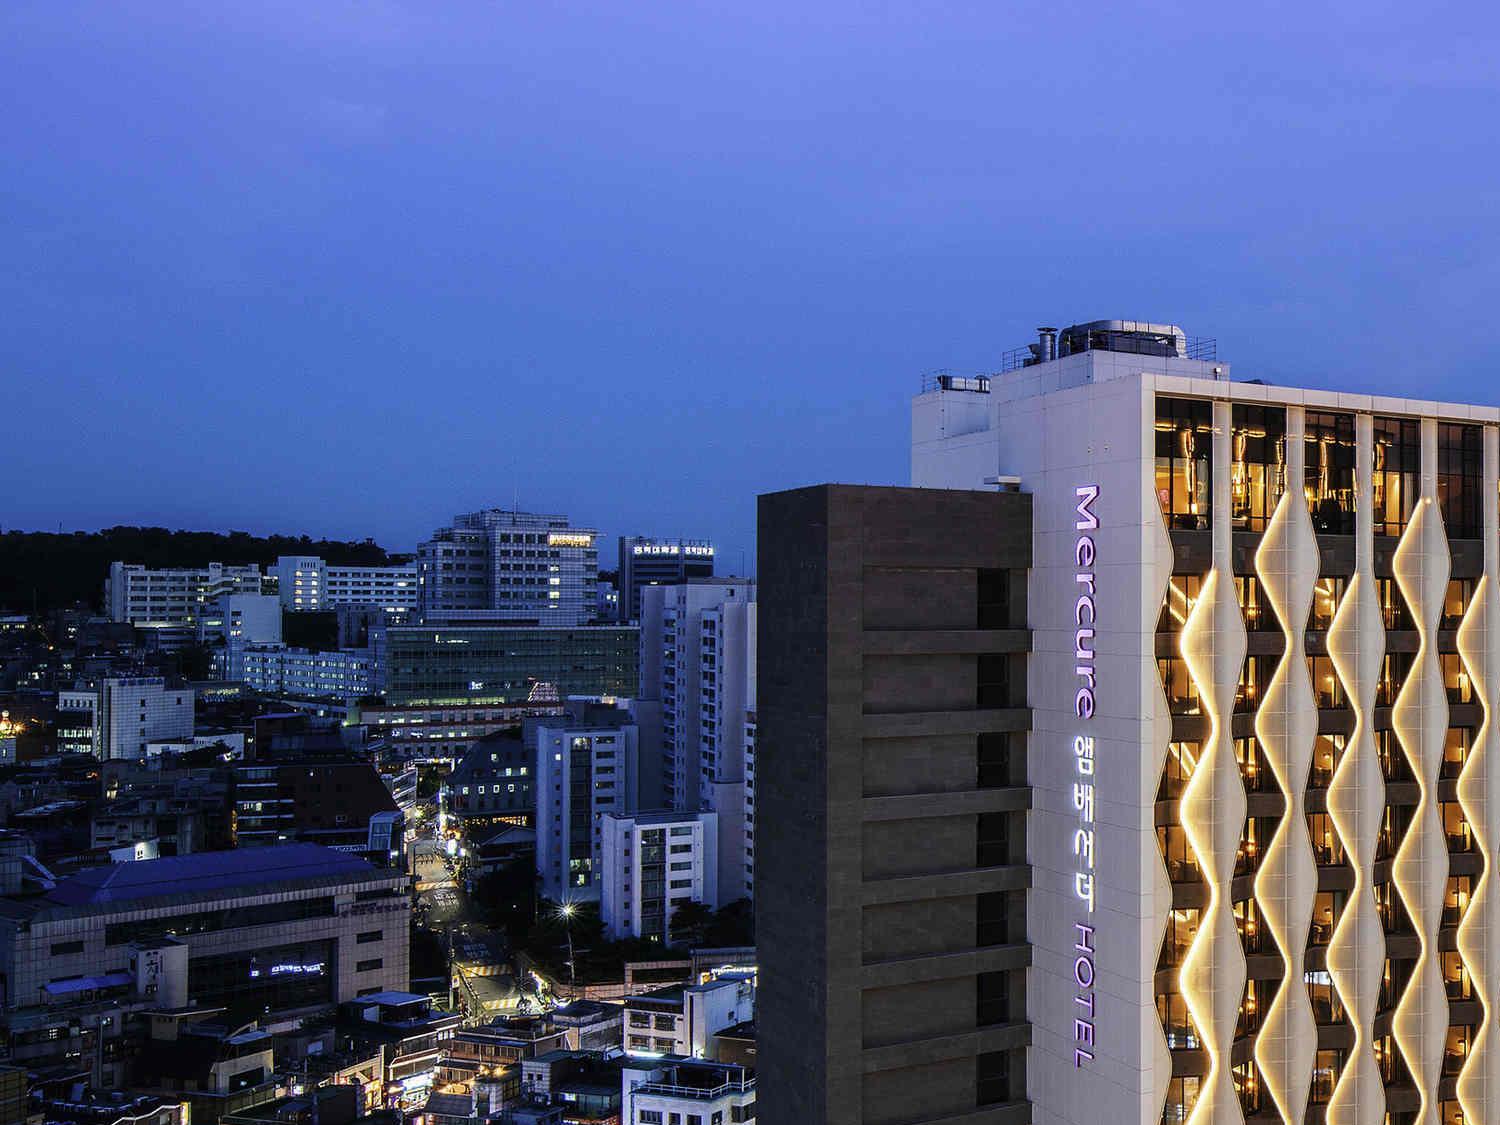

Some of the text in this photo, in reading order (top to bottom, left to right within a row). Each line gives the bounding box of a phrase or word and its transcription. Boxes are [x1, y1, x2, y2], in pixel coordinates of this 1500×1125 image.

[1073, 485, 1100, 1070] Mercure 앰배서더 HOTEL
